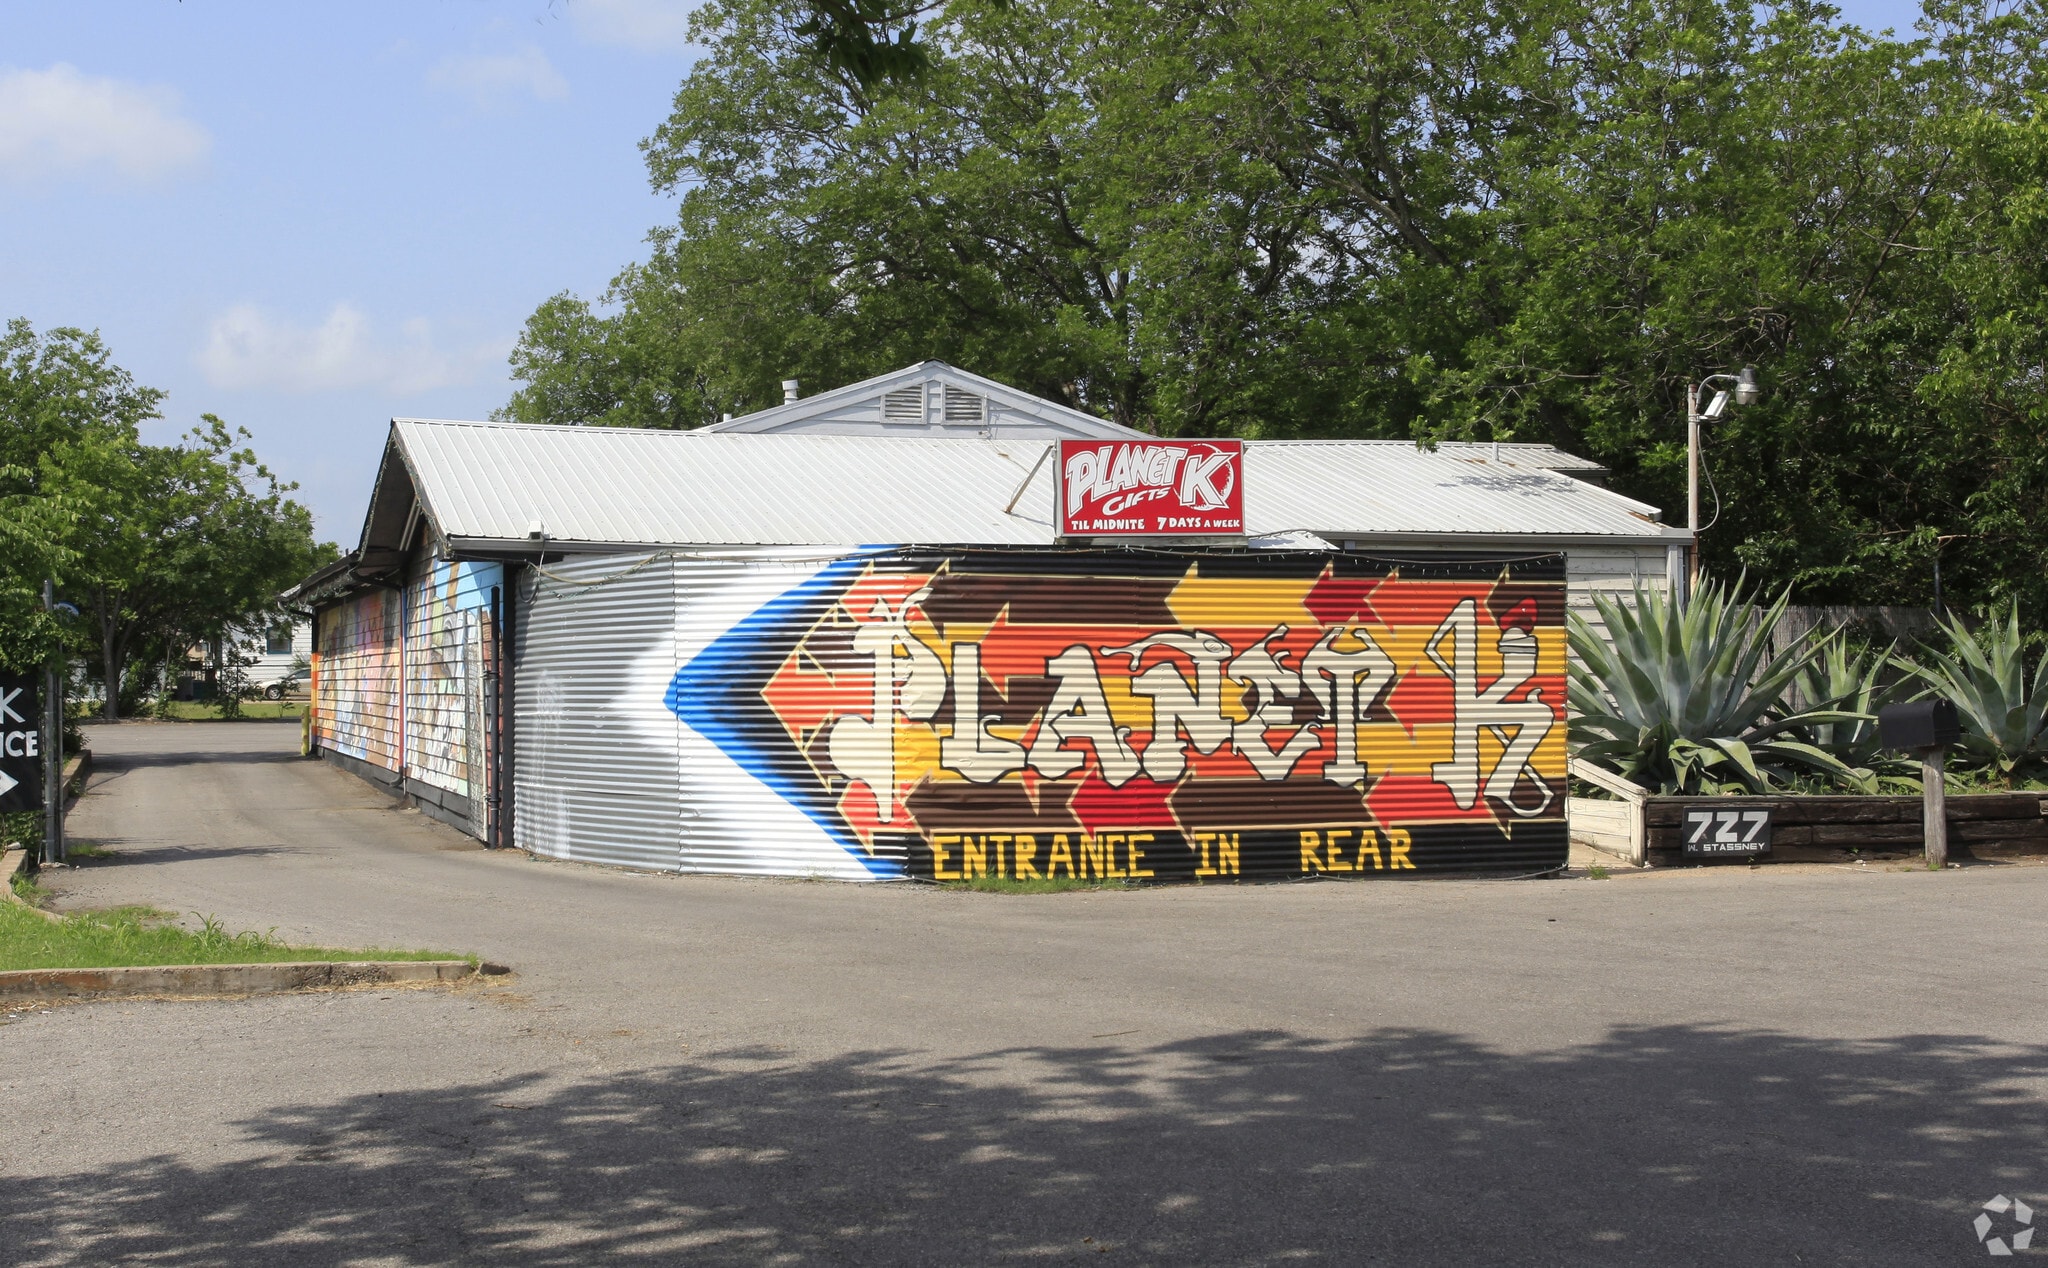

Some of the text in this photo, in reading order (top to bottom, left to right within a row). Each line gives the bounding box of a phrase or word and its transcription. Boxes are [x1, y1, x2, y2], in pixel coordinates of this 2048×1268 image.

[1065, 443, 1239, 518] PLANET K
[1102, 487, 1170, 516] GIFTS
[1072, 517, 1240, 530] TIL MIDNITE 7 DAYS A WEEK
[0, 731, 38, 757] CE
[1688, 811, 1768, 843] 727
[934, 829, 1416, 880] ENTRANCE IN REAR
[1703, 843, 1765, 851] STASSNEY
